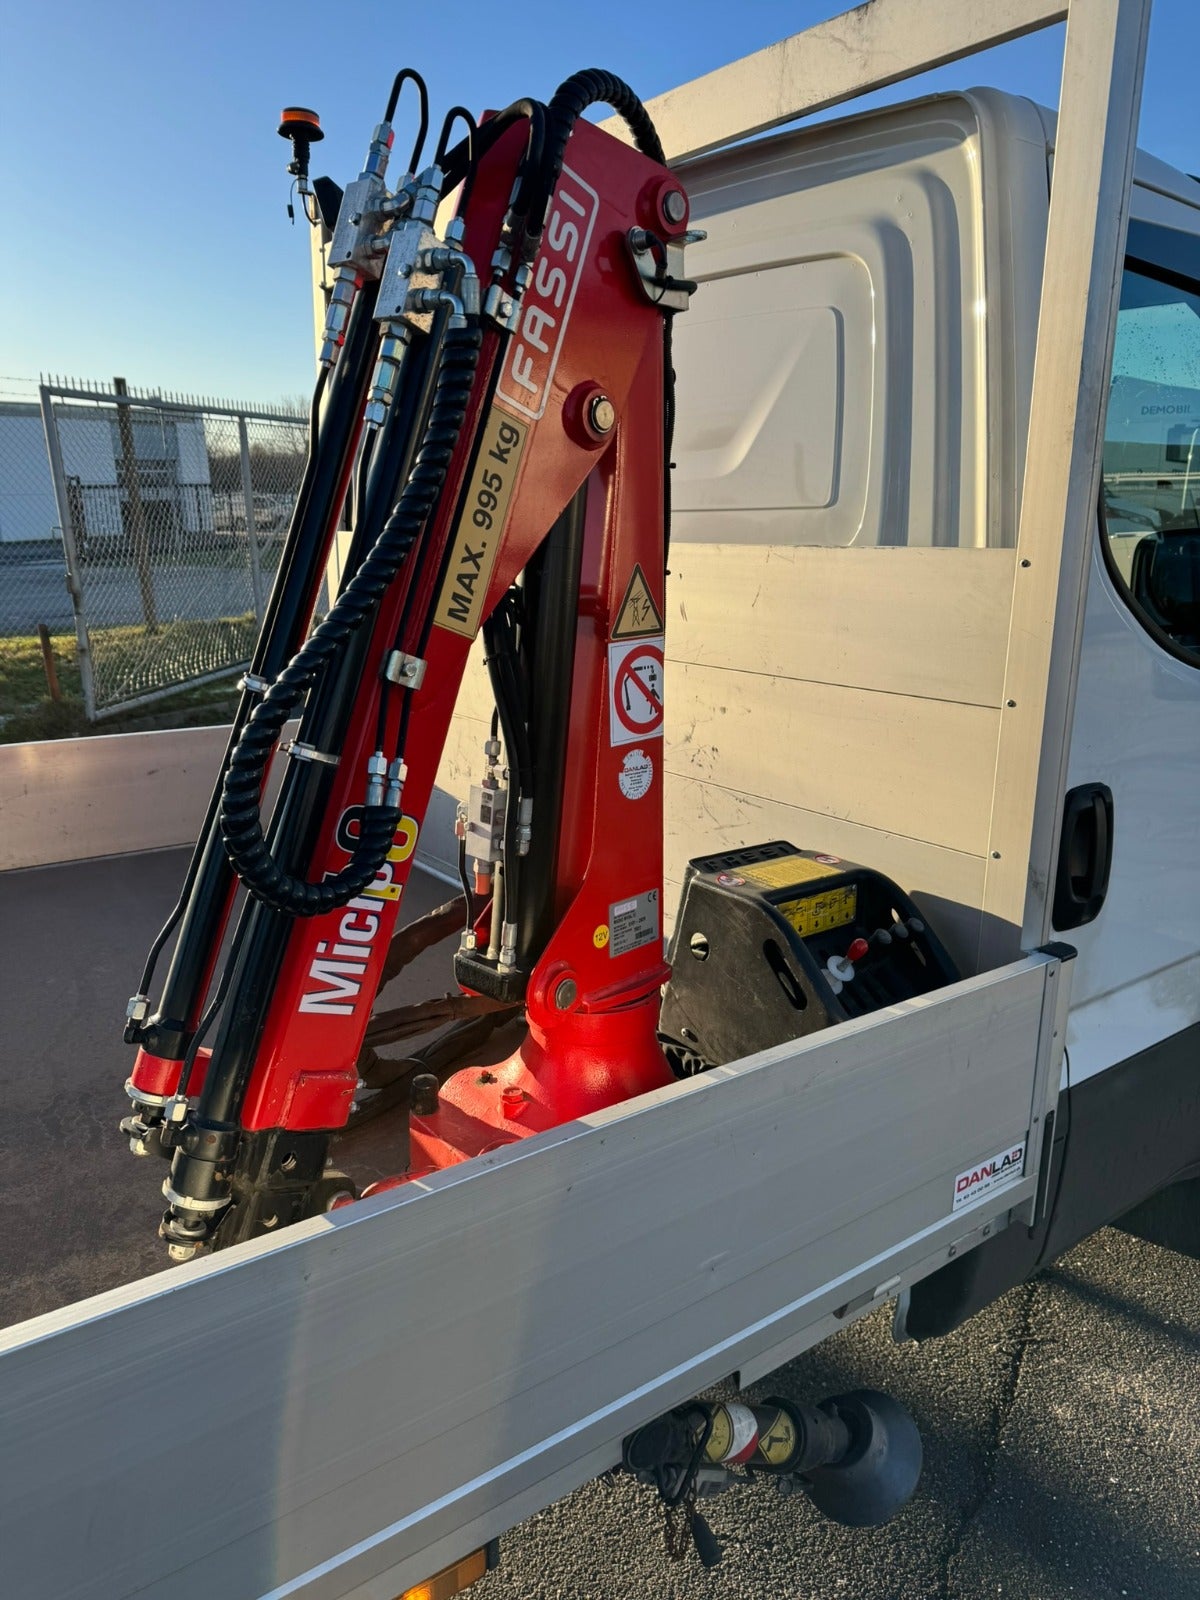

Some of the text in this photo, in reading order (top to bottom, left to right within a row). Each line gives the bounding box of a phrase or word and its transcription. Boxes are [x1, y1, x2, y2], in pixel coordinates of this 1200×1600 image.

[511, 190, 587, 395] FASSI
[447, 420, 521, 624] MAX. 995 kg
[595, 930, 608, 942] 12V
[957, 1148, 1023, 1193] DANLAD
